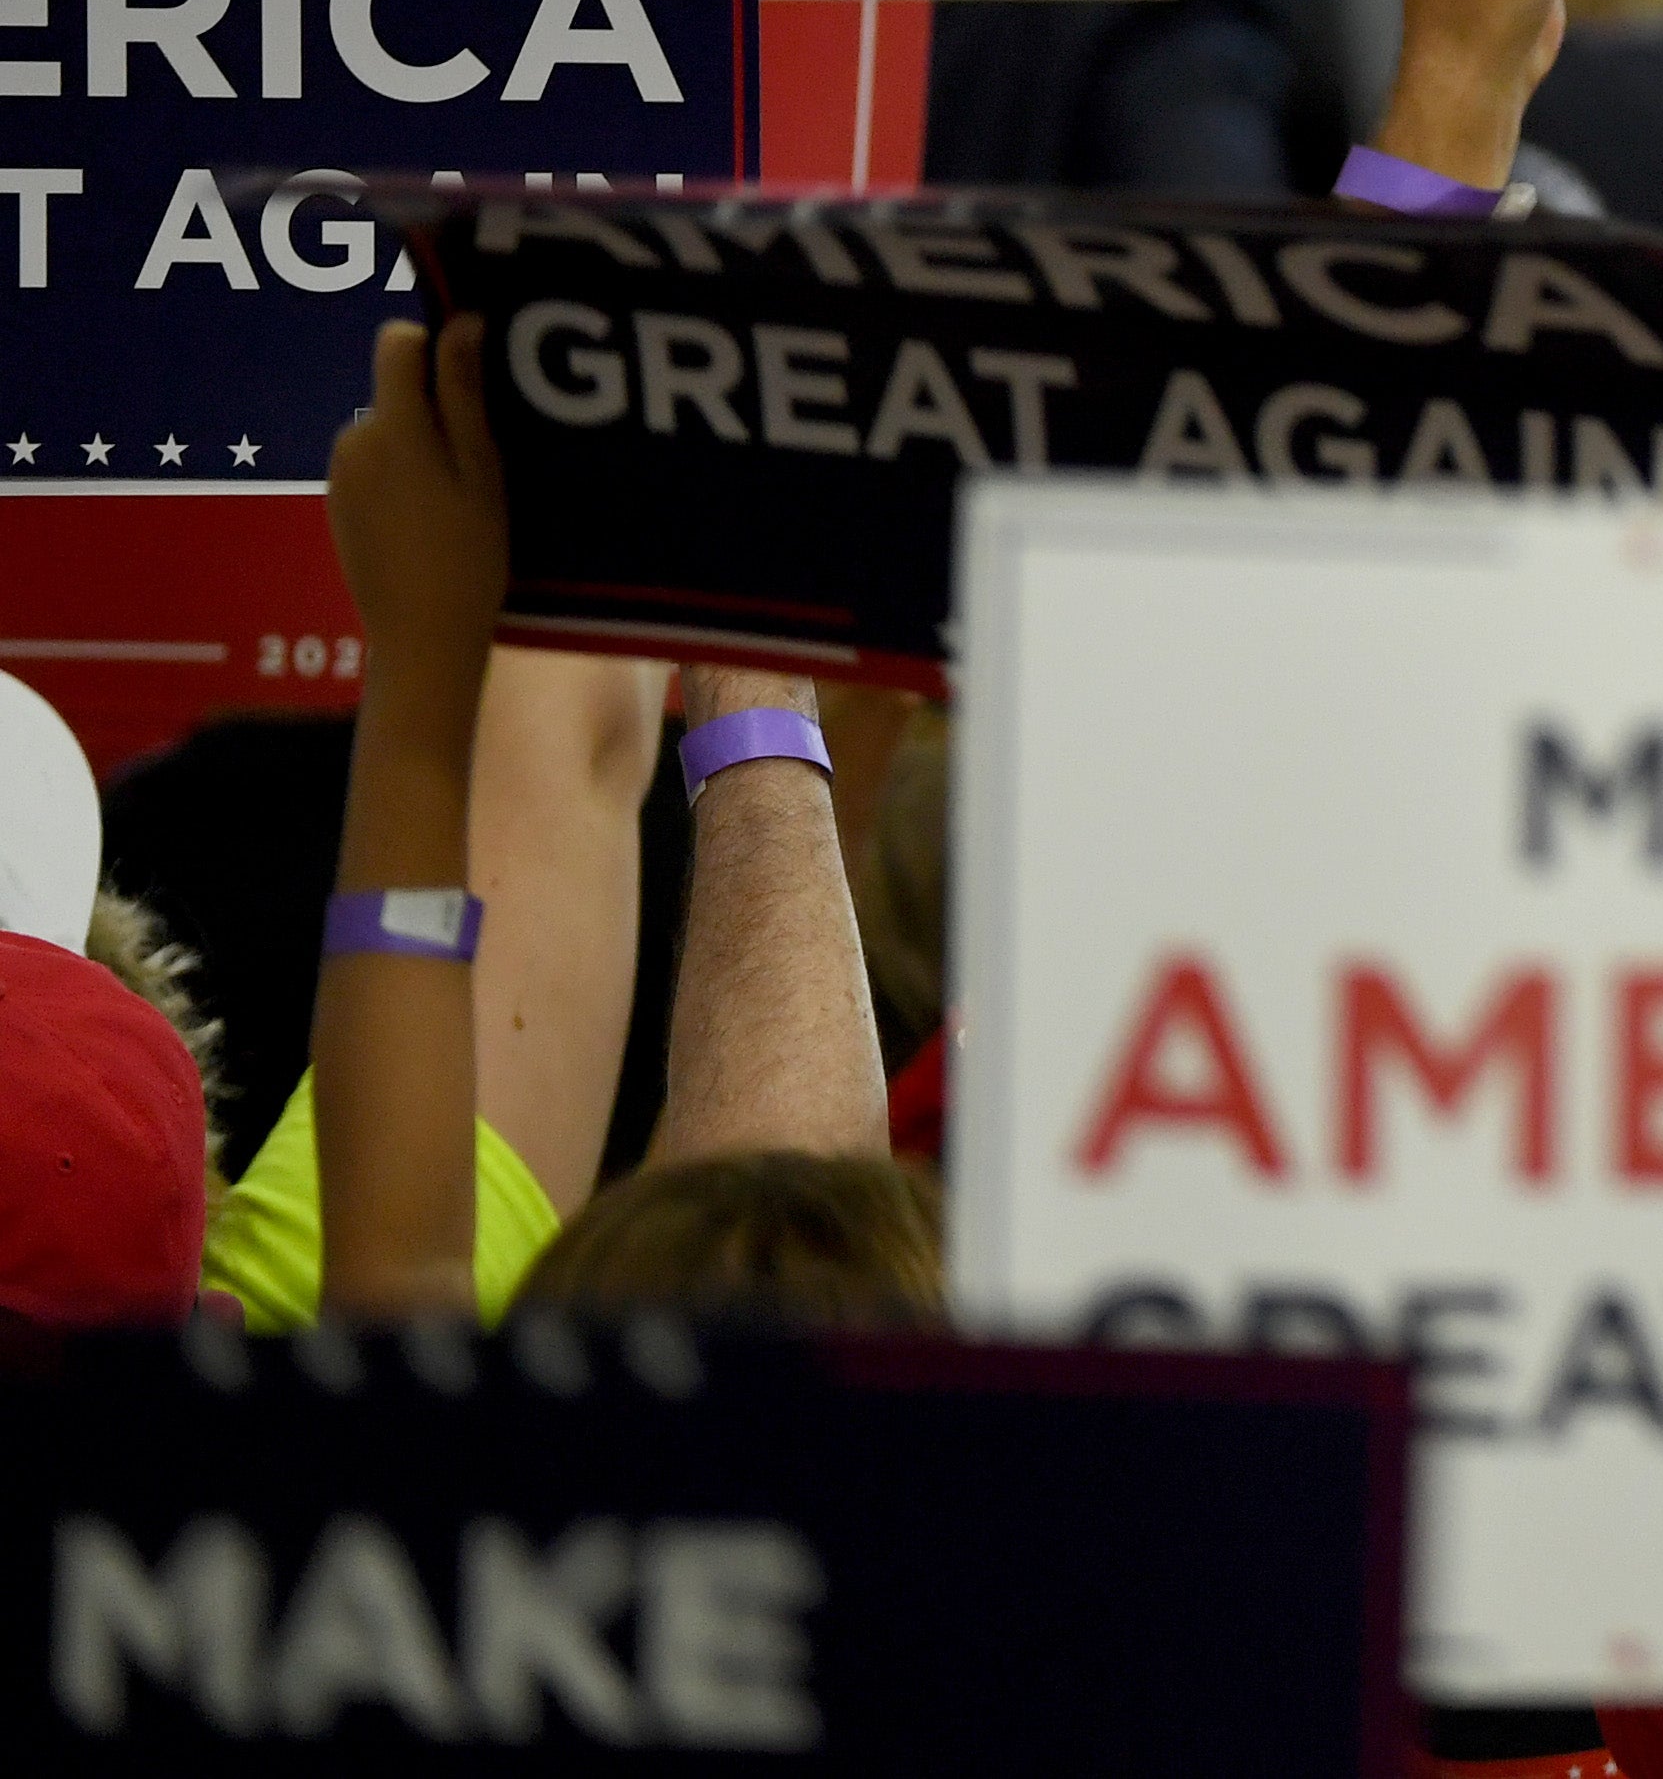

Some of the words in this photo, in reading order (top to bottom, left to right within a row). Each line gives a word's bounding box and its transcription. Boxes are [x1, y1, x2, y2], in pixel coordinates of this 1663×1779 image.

[507, 297, 1078, 475] GREAT
[256, 634, 364, 681] 202
[48, 1511, 828, 1751] MAKE
